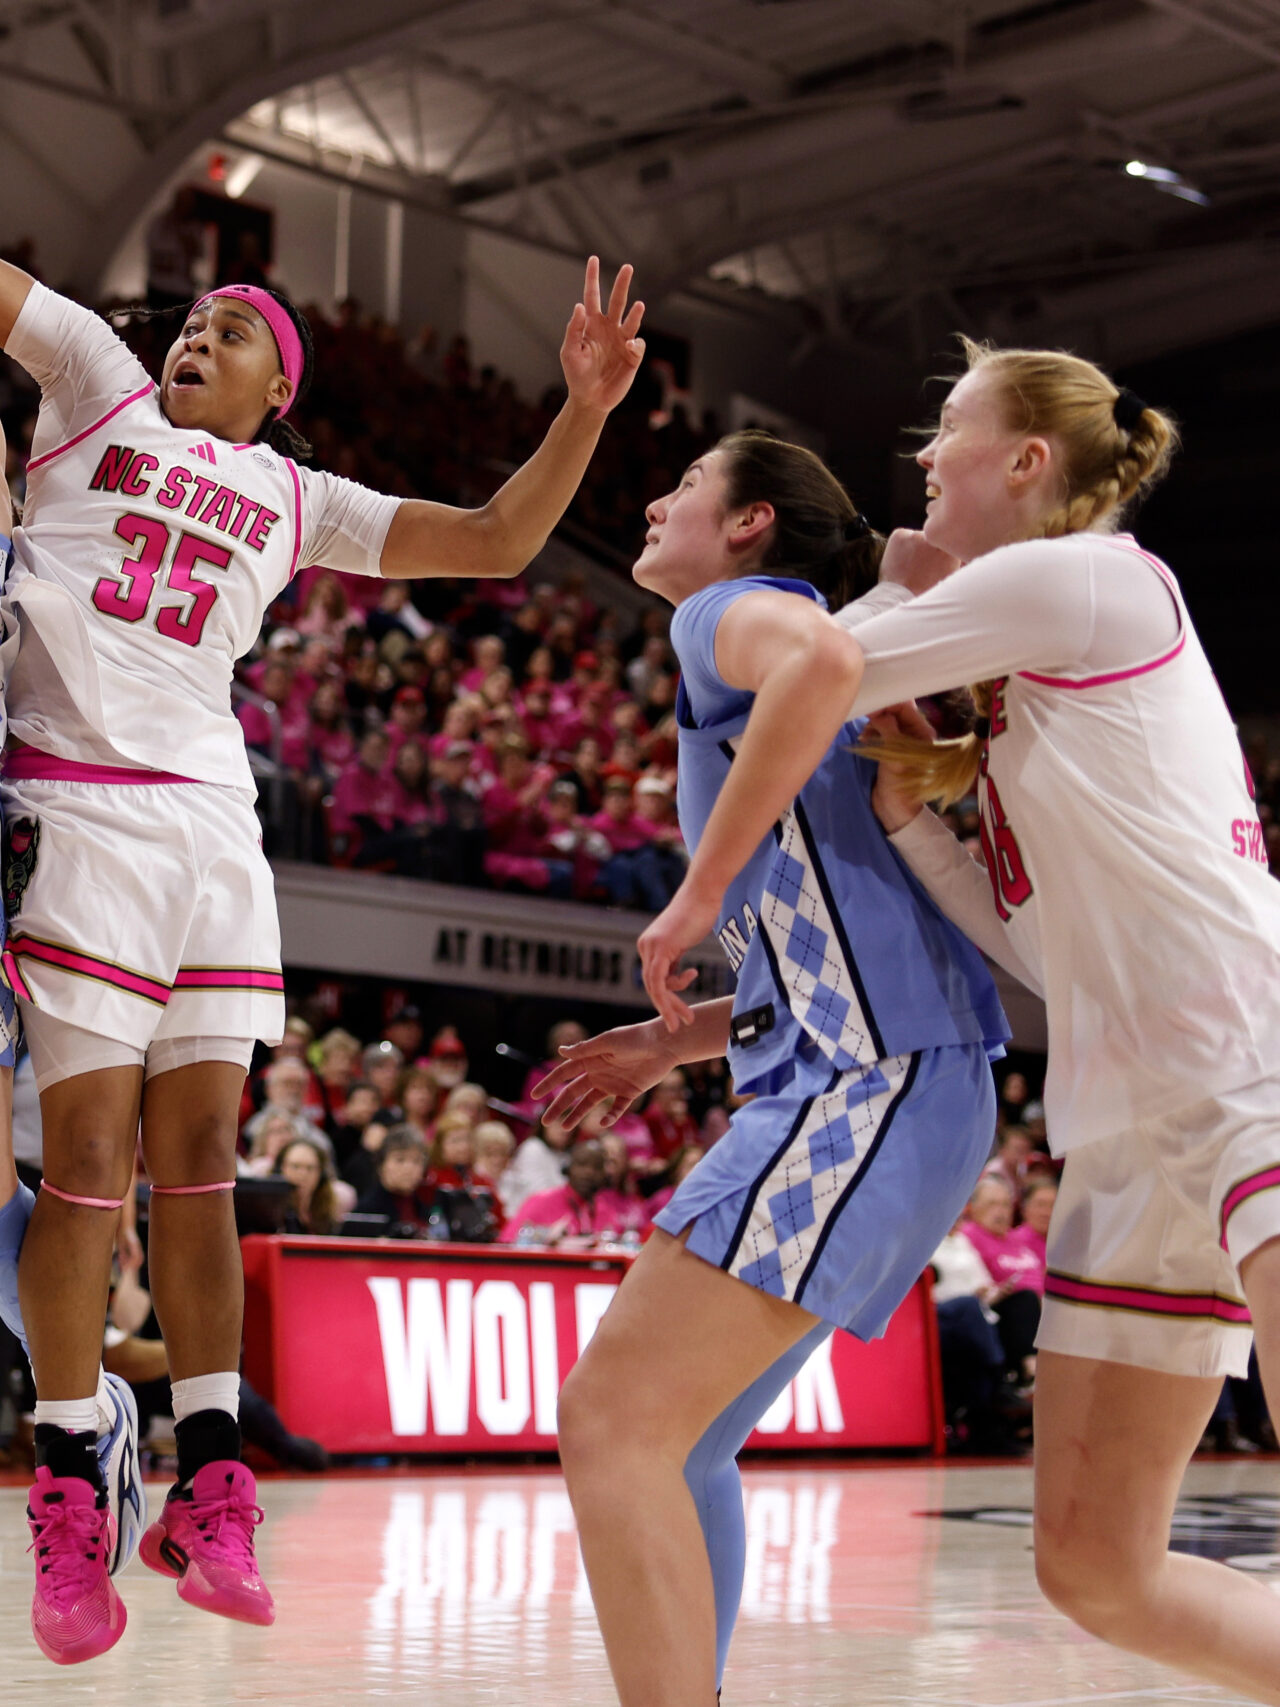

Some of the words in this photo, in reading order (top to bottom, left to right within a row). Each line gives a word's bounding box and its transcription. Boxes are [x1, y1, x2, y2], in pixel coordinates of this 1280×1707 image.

[87, 443, 160, 497] NC
[154, 465, 283, 554] STATE
[91, 511, 235, 647] 35
[434, 926, 469, 965] AT
[479, 933, 624, 985] REYNOLDS
